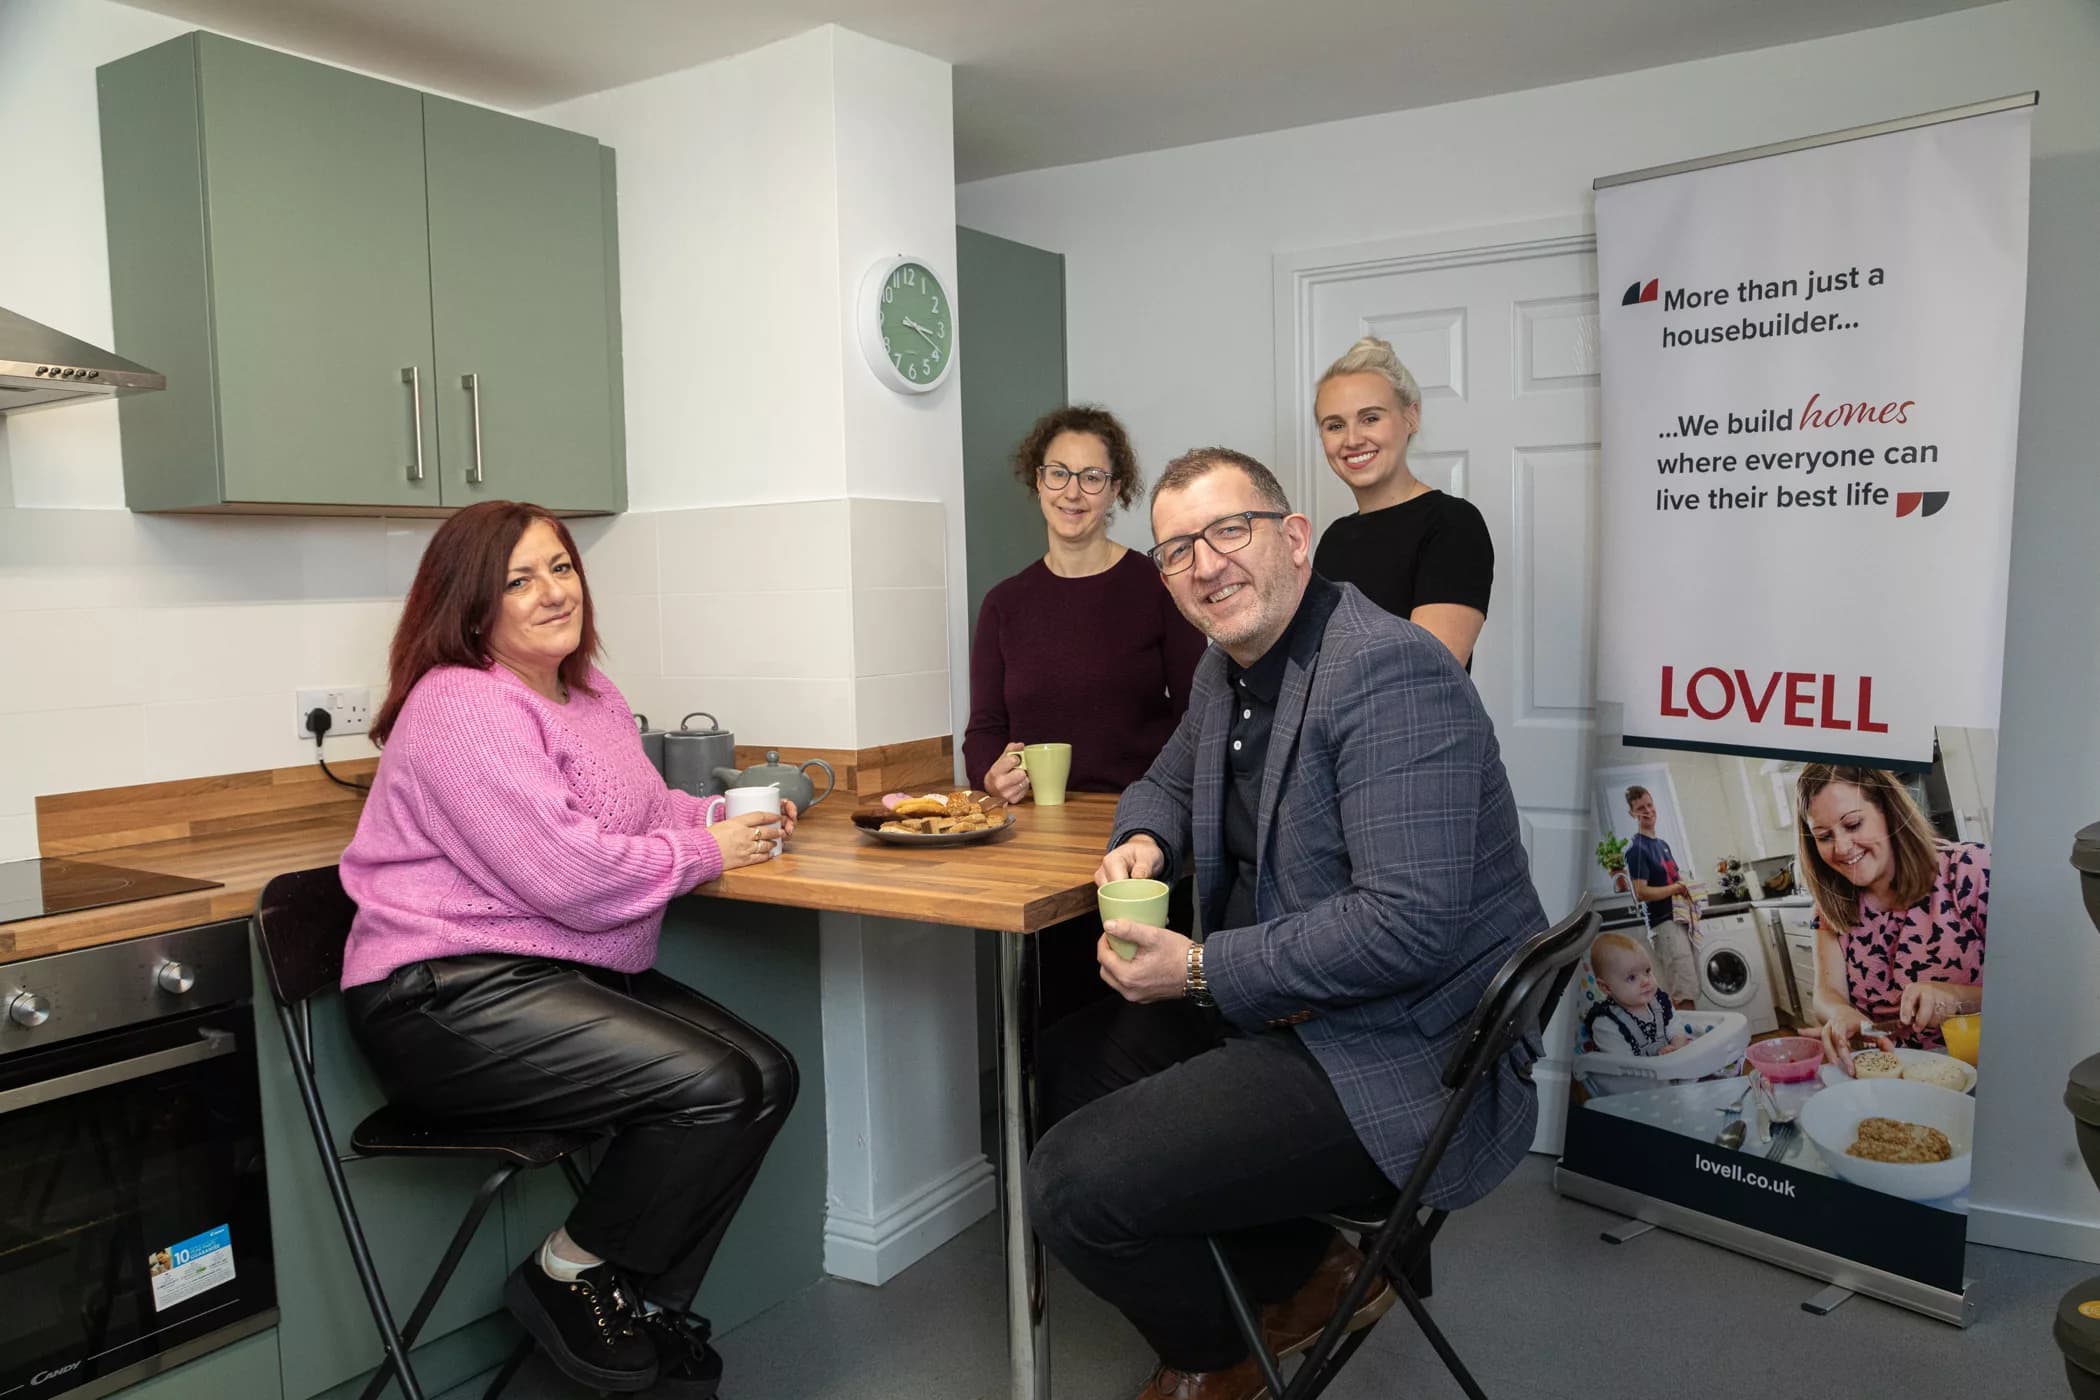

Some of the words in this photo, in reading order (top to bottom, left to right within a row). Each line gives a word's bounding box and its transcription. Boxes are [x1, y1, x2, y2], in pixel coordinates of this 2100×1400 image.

[892, 270, 900, 289] 11
[903, 267, 916, 287] 12
[921, 277, 926, 295] 1
[881, 286, 893, 304] 10
[1664, 287, 1729, 312] More
[1737, 278, 1799, 304] than
[1804, 267, 1860, 301] just
[1868, 267, 1885, 286] a
[931, 296, 939, 314] 2
[937, 321, 945, 339] 3
[1662, 311, 1859, 348] housebuilder...
[894, 353, 902, 369] 7
[922, 358, 931, 376] 5
[908, 363, 917, 380] 6
[1658, 415, 1719, 438] ...We
[1727, 408, 1793, 435] build
[1799, 393, 1915, 431] homes
[1657, 452, 1737, 475] where
[1744, 446, 1875, 475] everyone
[1884, 443, 1939, 465] can
[1656, 488, 1700, 511] live
[1707, 485, 1769, 510] their
[1776, 482, 1837, 507] best
[1845, 481, 1889, 507] life
[1660, 666, 1889, 733] LOVELL
[1695, 1153, 1796, 1198] lovell.co.uk
[174, 1248, 190, 1266] 10
